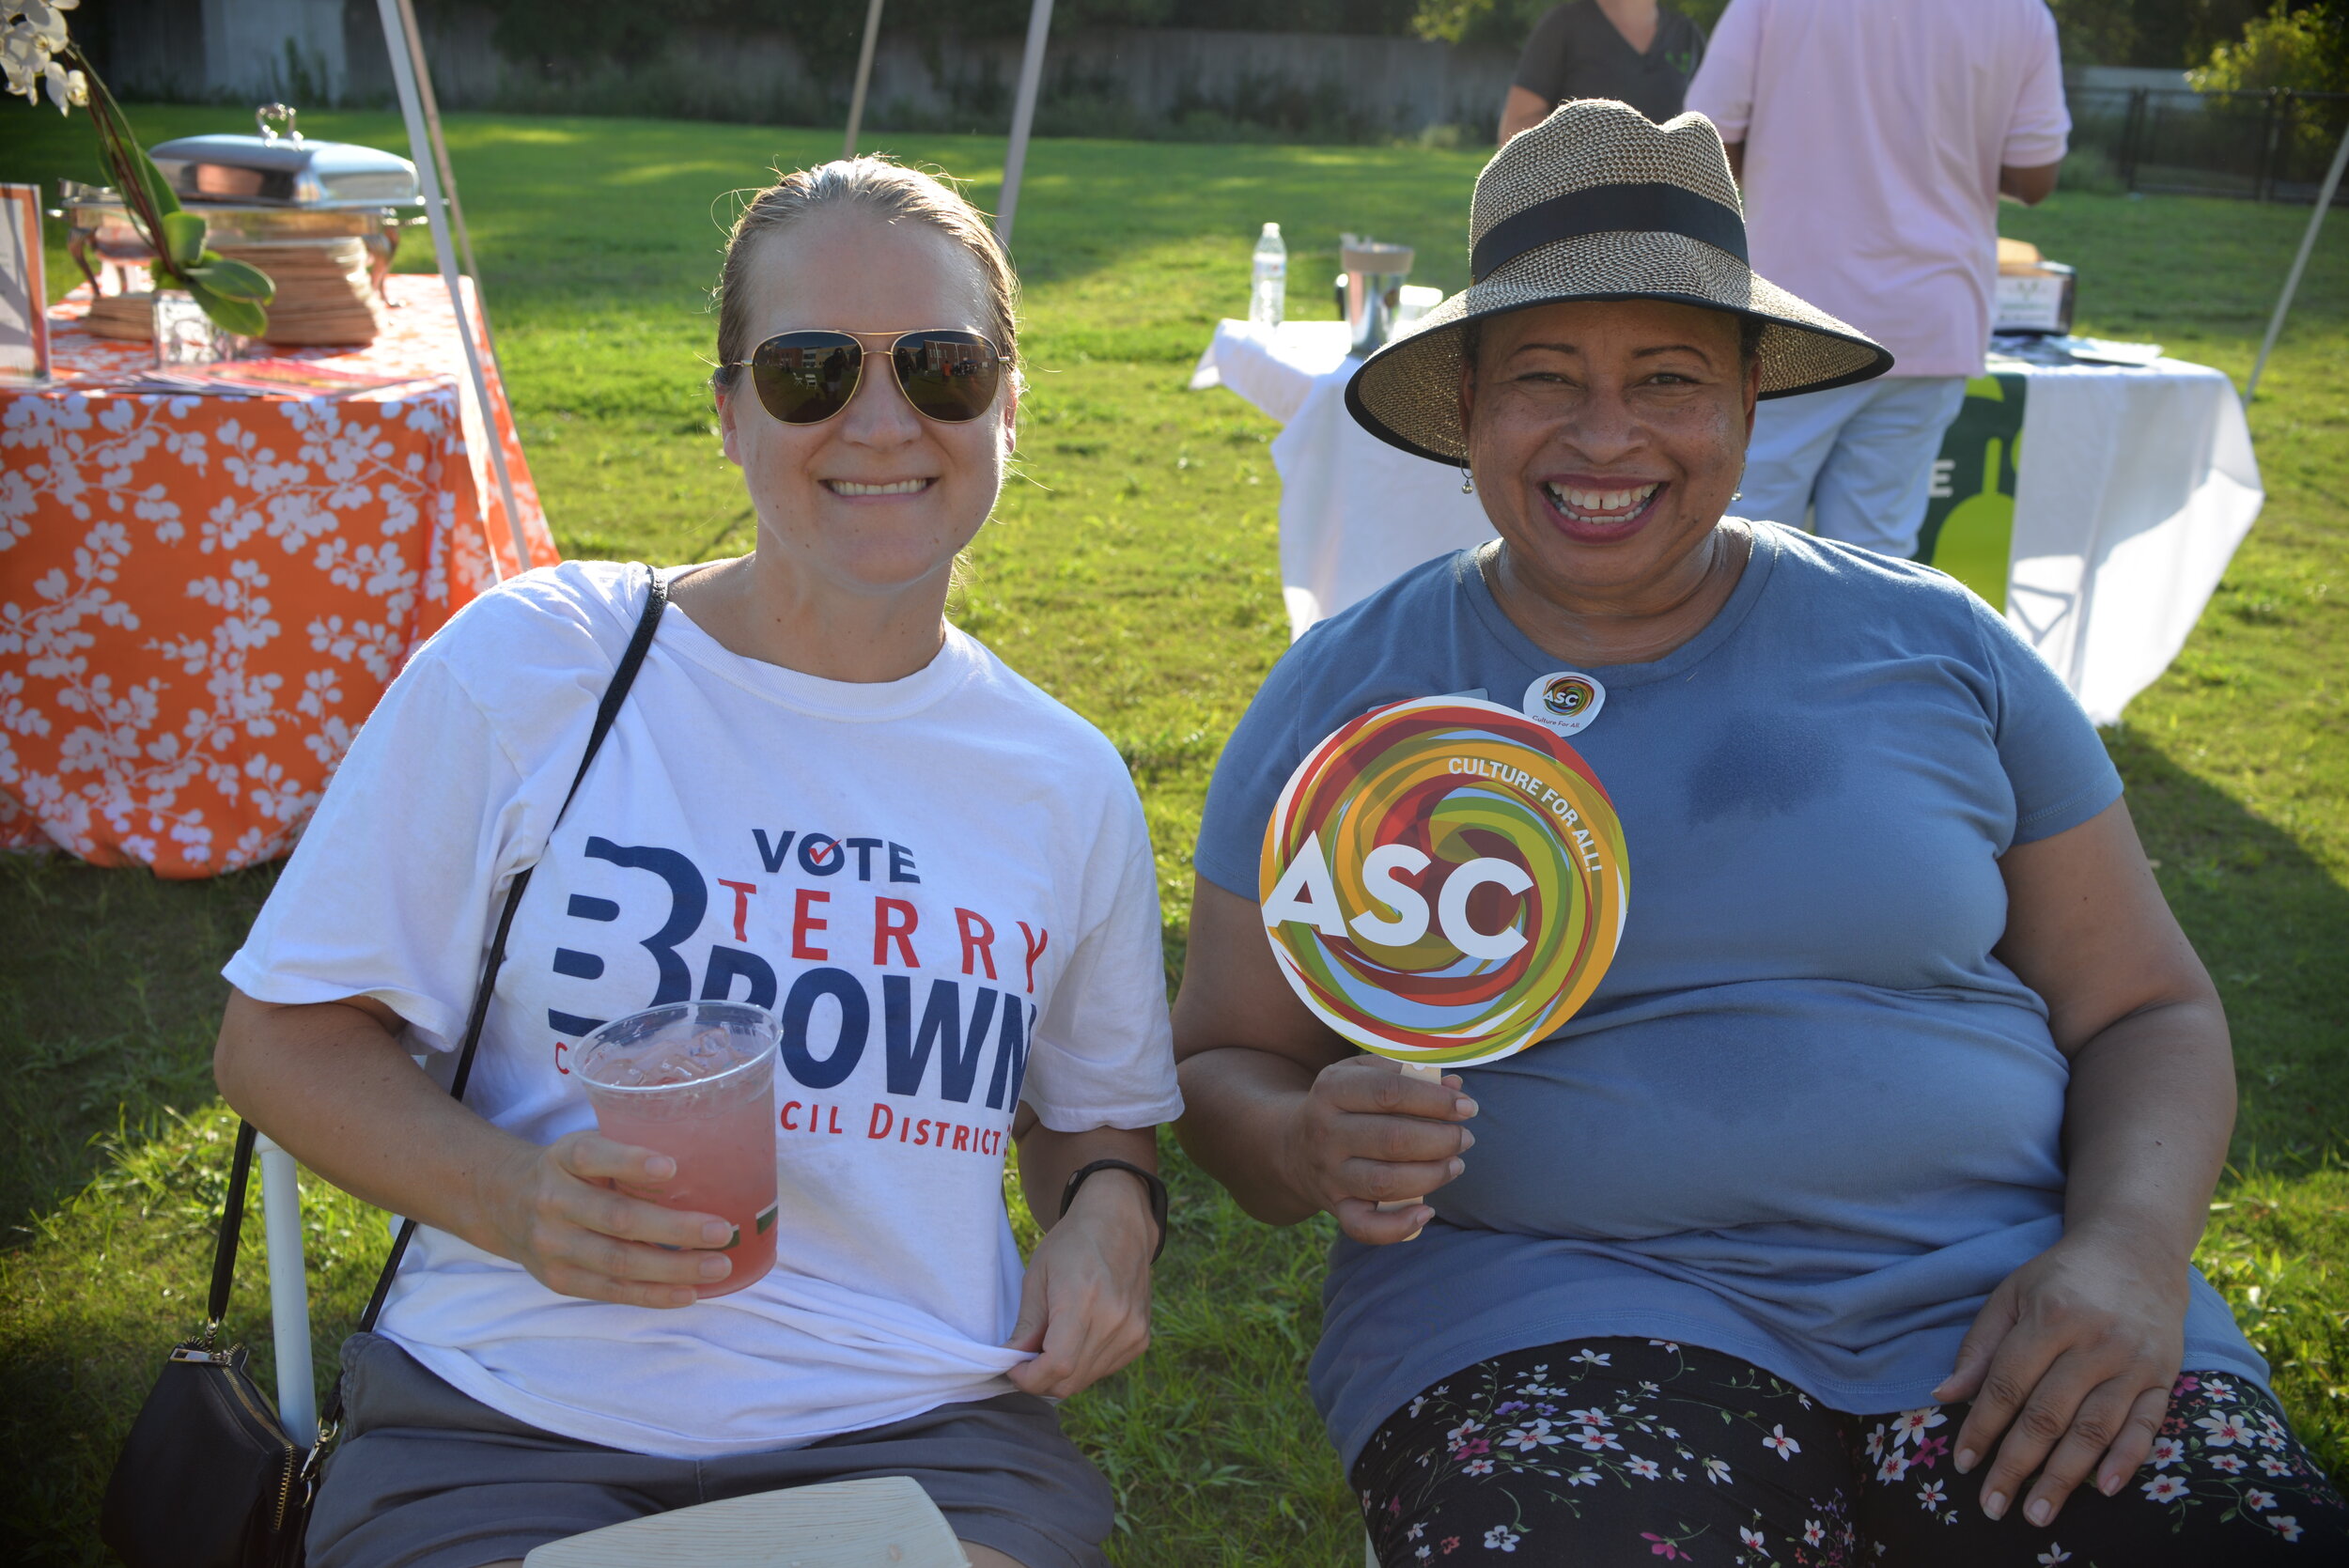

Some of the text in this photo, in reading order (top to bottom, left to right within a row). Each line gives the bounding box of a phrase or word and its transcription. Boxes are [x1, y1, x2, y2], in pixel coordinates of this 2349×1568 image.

[1532, 715, 1557, 725] Culture
[1543, 690, 1579, 706] ASC
[1448, 757, 1602, 872] CULTURE FOR ALL!
[752, 829, 921, 884] VOTE
[1262, 830, 1534, 960] ASC
[718, 878, 1049, 994] TERRY
[868, 1102, 1002, 1157] DISTRICT
